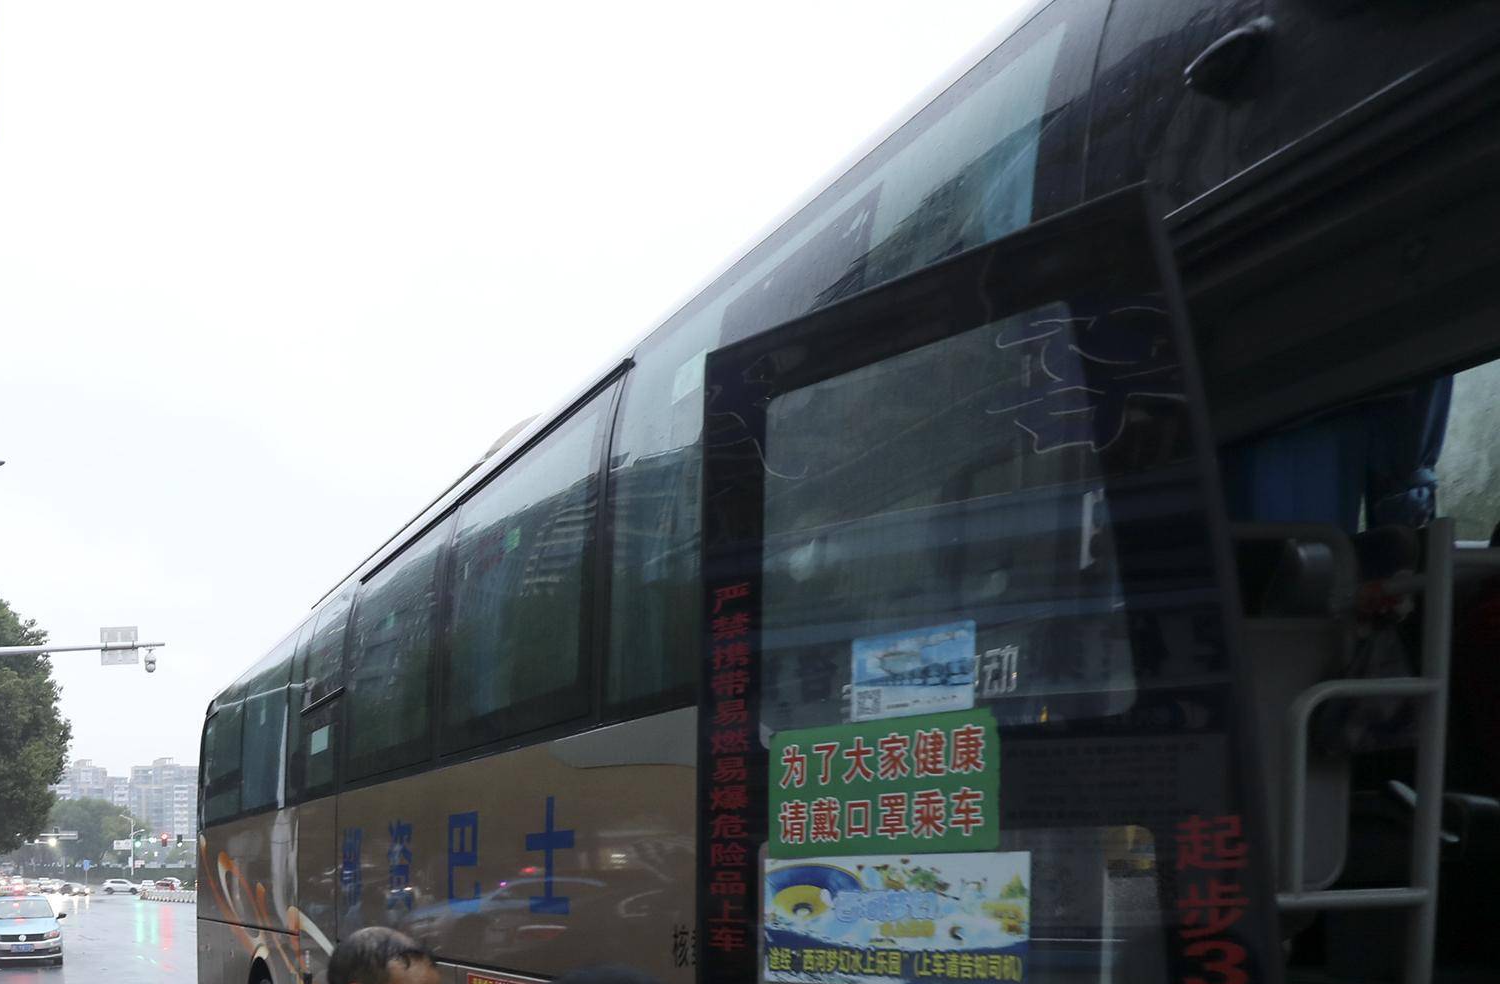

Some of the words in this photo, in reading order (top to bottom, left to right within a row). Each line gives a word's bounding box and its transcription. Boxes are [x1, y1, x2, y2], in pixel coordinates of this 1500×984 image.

[709, 582, 749, 952] 严禁携带易燃易爆危险品上车
[779, 724, 985, 788] 为了大家健康
[779, 786, 985, 845] 请戴口罩乘车
